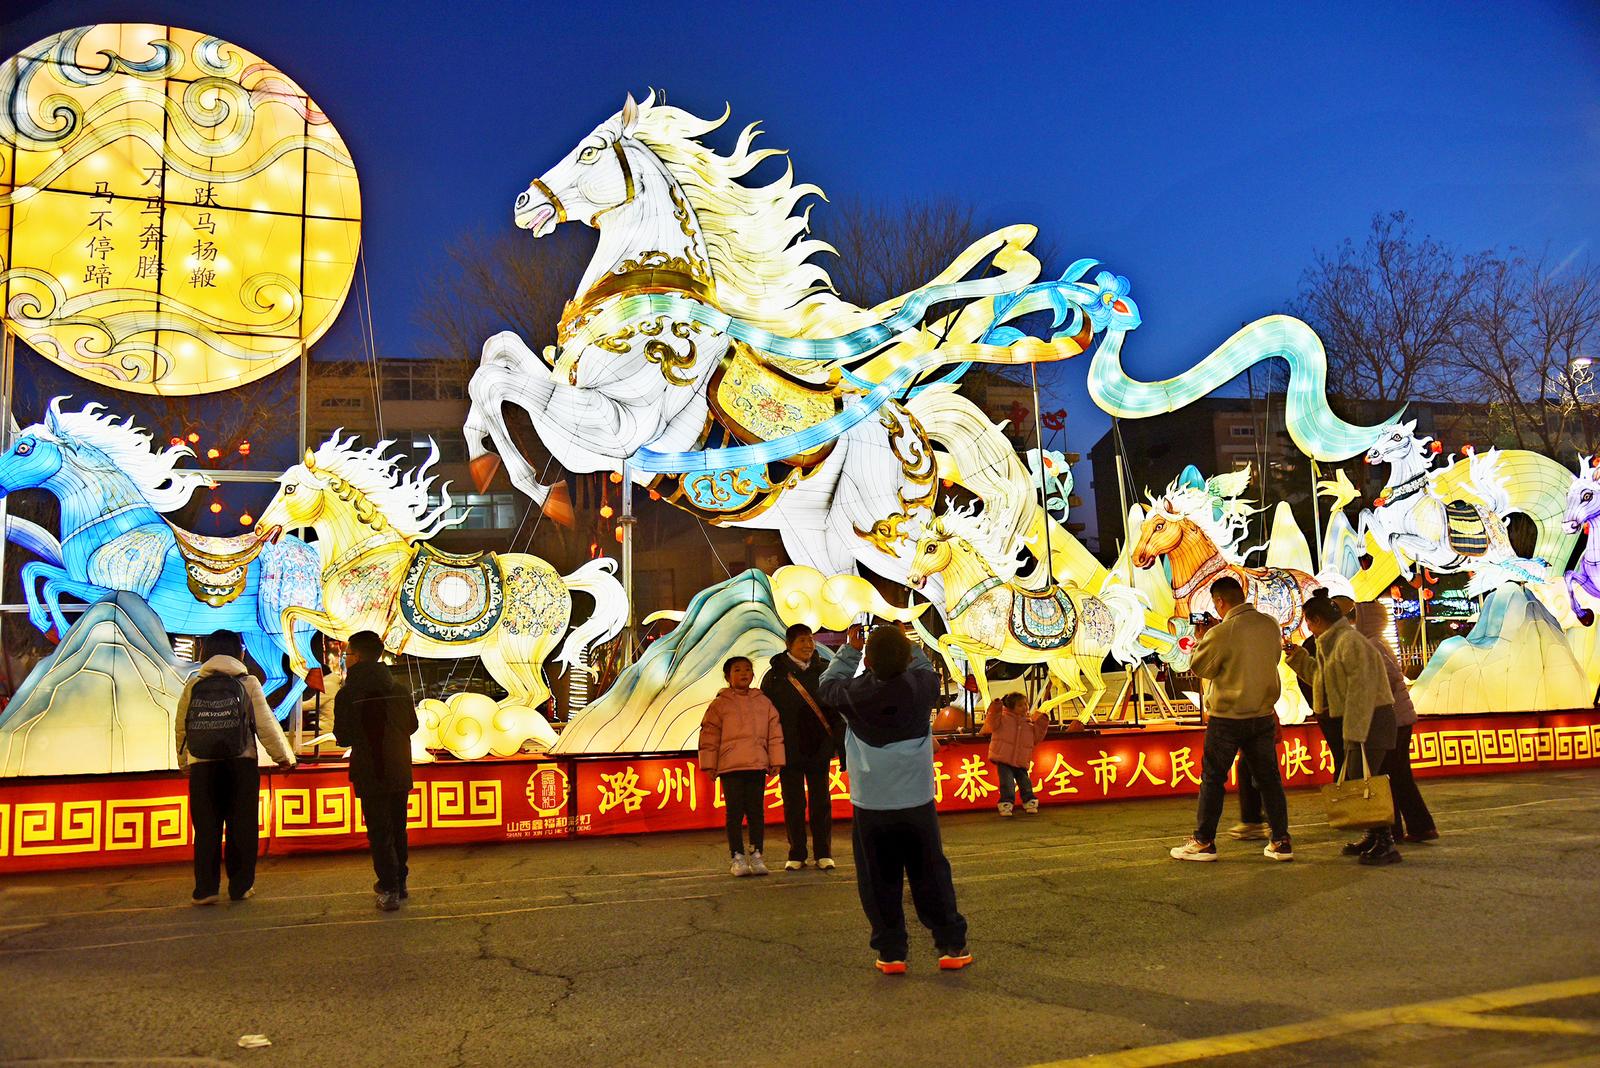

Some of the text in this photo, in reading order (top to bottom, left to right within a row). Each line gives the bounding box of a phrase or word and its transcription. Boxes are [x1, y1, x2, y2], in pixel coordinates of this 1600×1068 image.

[83, 181, 114, 288] 马不停蹄
[135, 168, 170, 281] 万马奔腾
[189, 187, 221, 288] 跃马扬鞭
